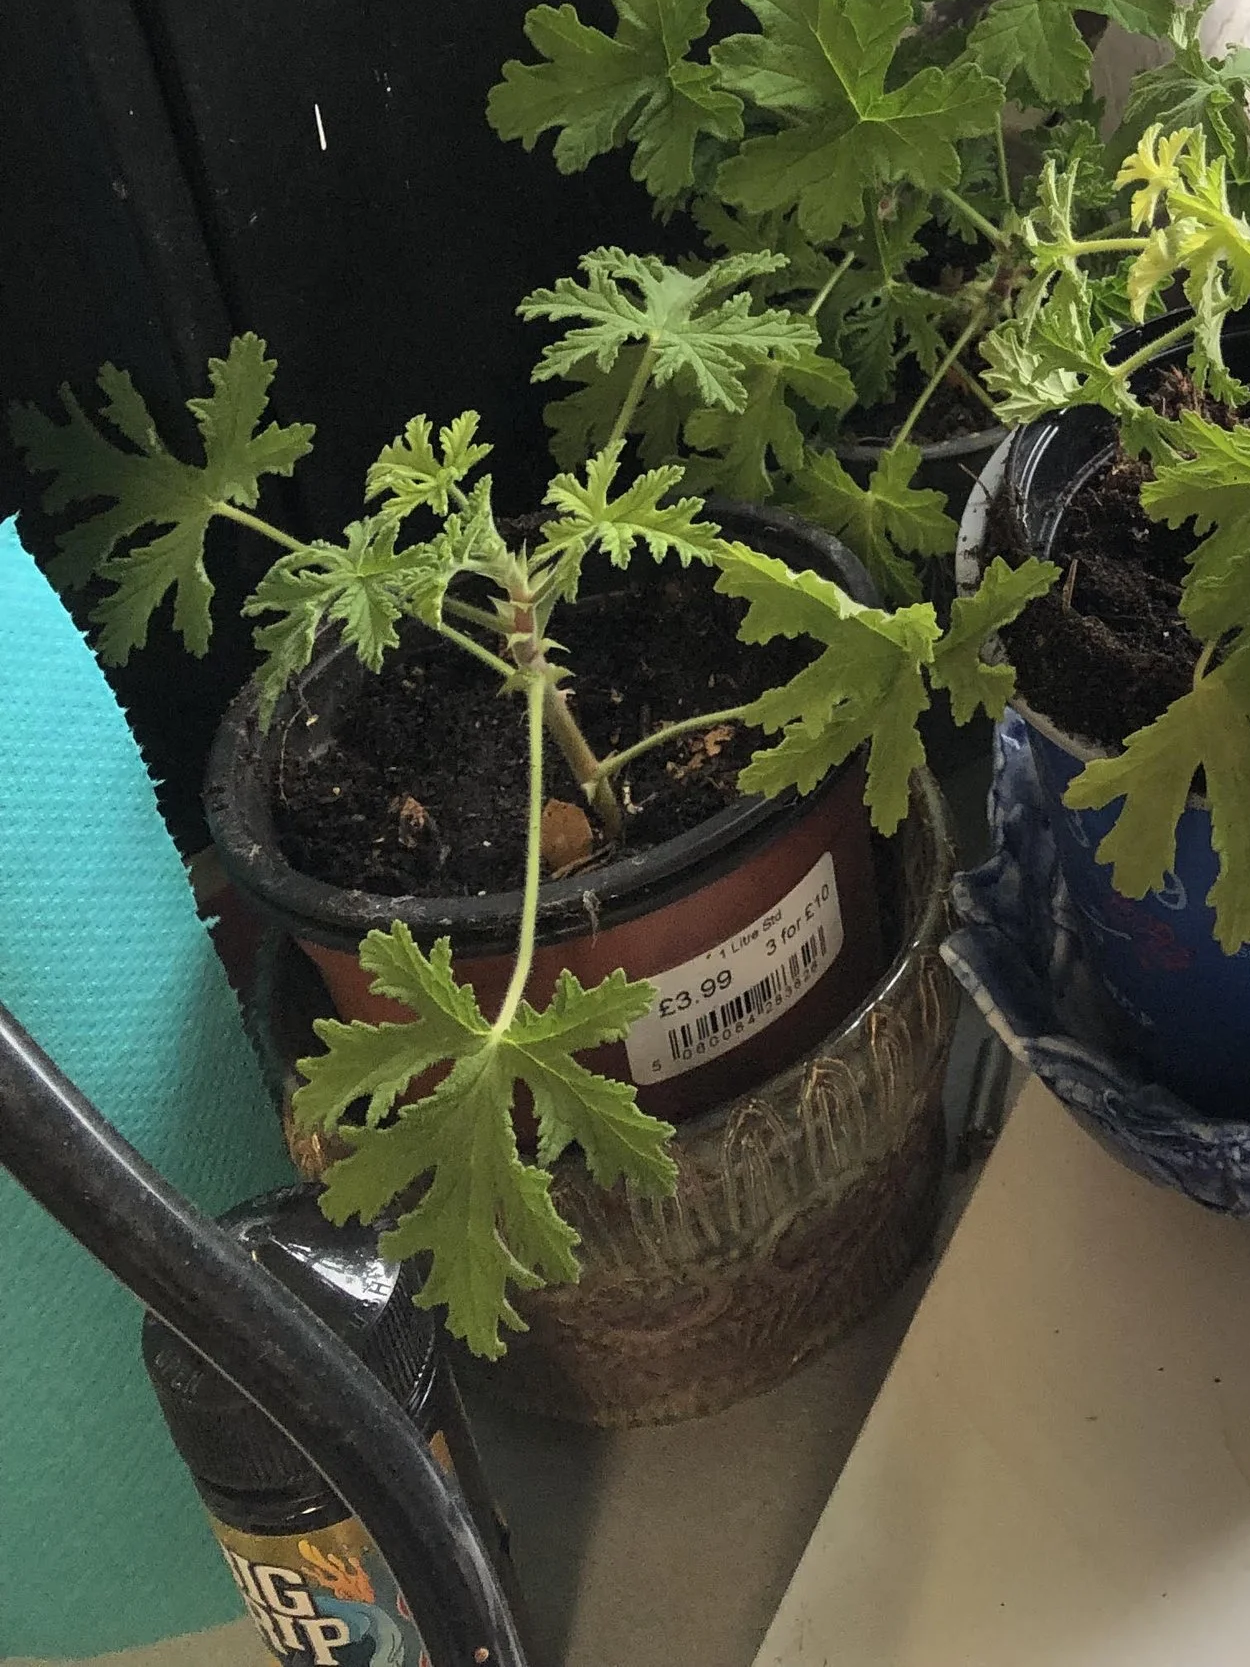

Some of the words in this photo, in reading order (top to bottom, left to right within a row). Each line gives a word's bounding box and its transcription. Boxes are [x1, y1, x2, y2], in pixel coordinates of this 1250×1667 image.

[764, 937, 778, 957] 3
[781, 917, 802, 945] for
[804, 883, 830, 922] £10
[659, 968, 733, 1019] £3.99
[651, 1058, 663, 1073] 5
